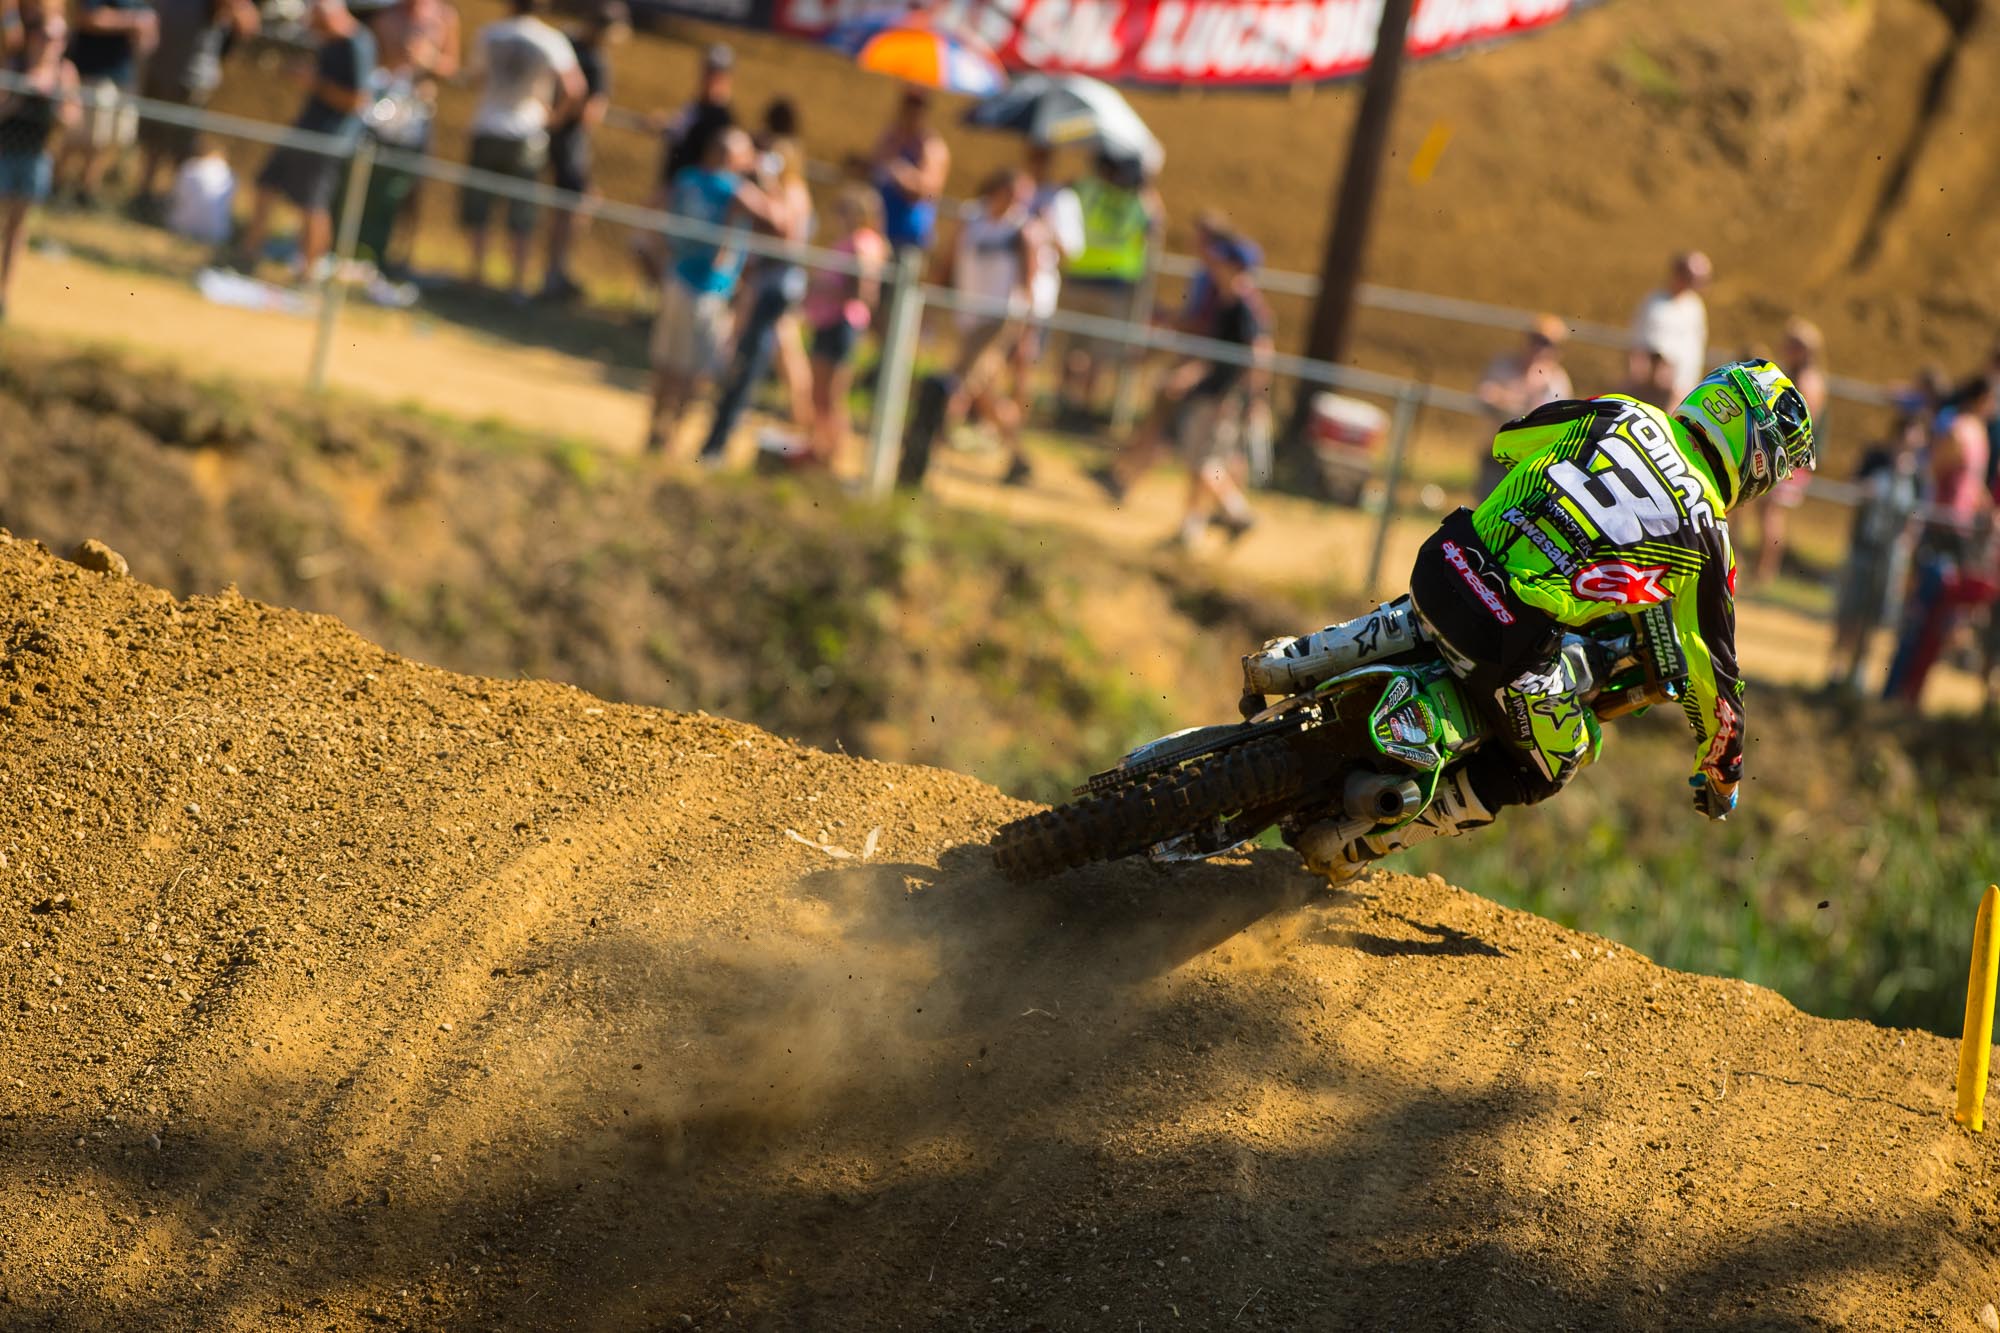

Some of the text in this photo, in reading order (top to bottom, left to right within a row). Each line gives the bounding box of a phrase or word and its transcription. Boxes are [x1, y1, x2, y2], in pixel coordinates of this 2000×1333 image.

[1702, 388, 1743, 424] 3
[1547, 436, 1680, 546] 3
[1754, 453, 1763, 475] BELL
[1502, 507, 1577, 576] Kawasaki
[1645, 608, 1668, 677] RENTHAL
[1654, 605, 1679, 674] RENTHAL
